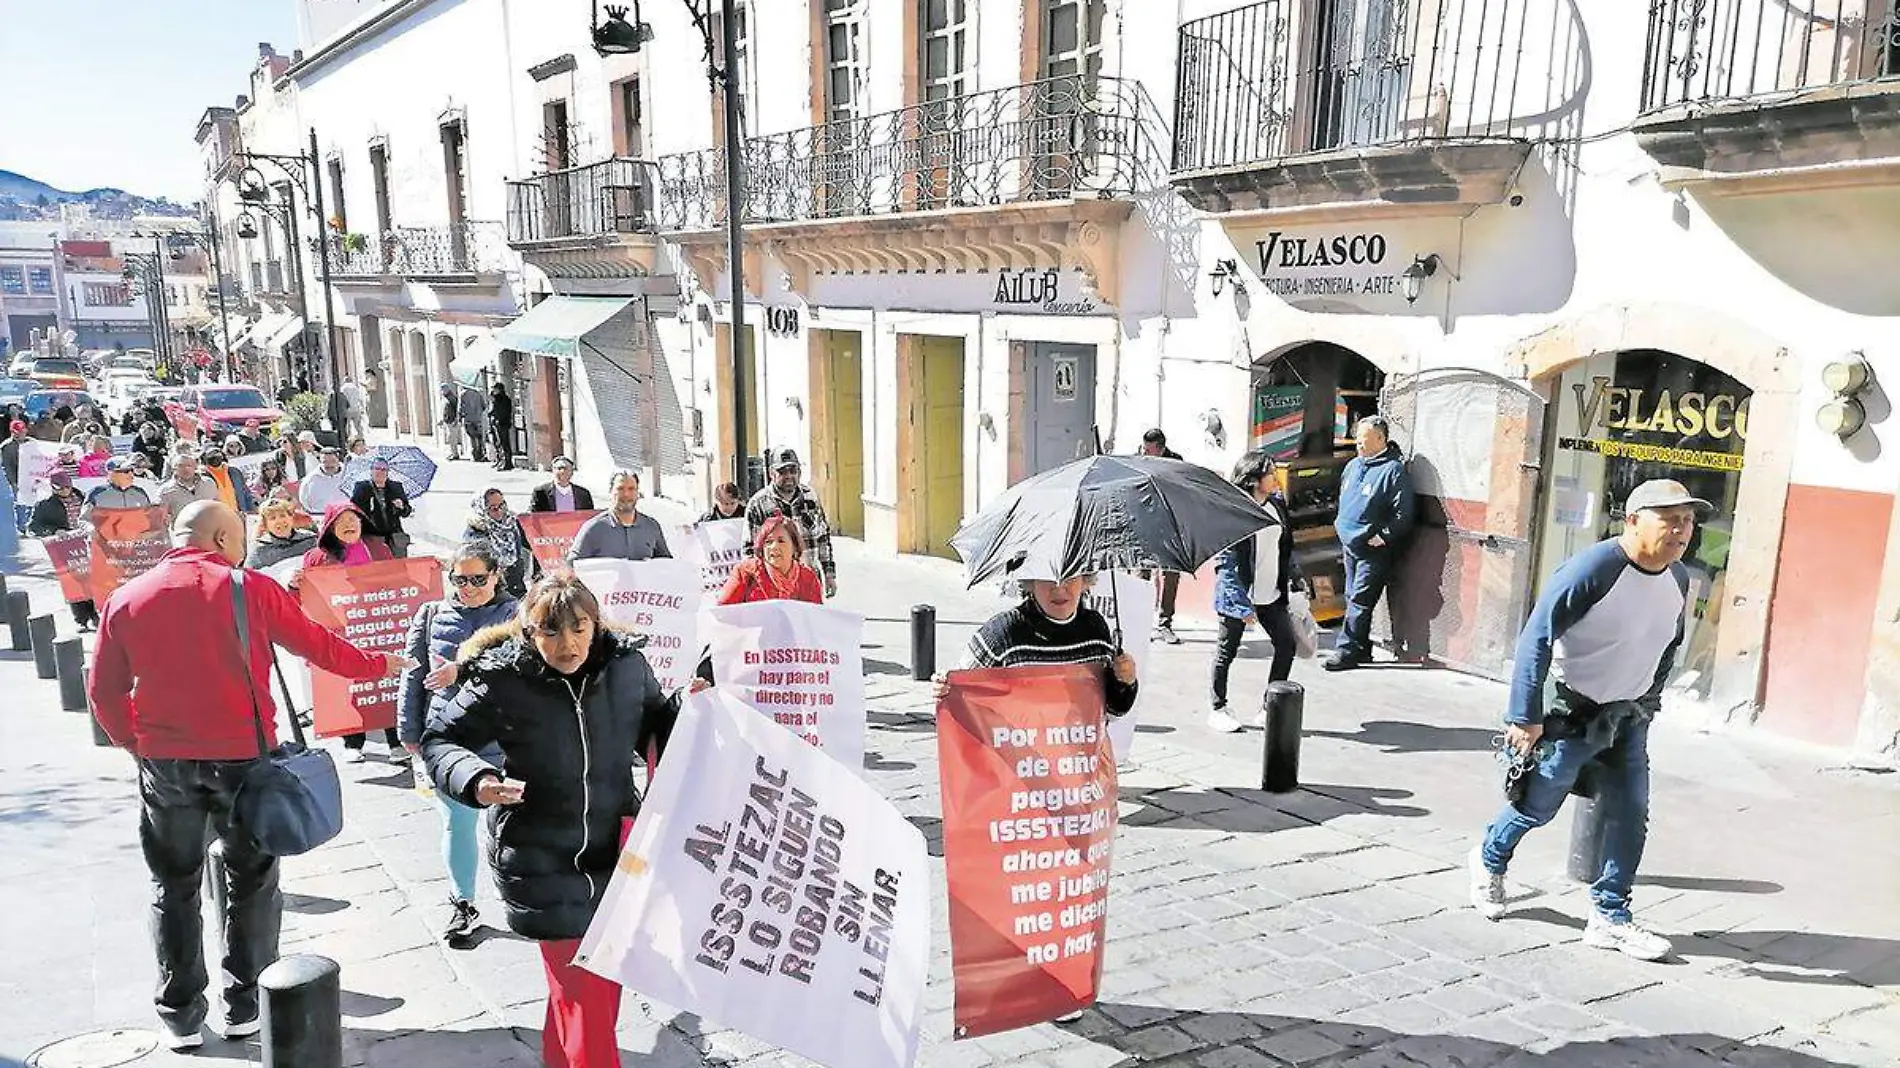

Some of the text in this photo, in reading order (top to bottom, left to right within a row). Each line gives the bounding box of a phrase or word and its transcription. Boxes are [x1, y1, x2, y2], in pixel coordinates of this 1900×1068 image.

[1256, 232, 1386, 276] VELASCO
[1361, 275, 1394, 294] ARTE
[1628, 442, 1671, 461] EQUIPOS
[1674, 448, 1702, 464] PARA
[1703, 451, 1743, 471] INGENIE
[330, 587, 418, 606] Por más 30
[604, 591, 683, 610] ISSSTEZAC
[346, 603, 408, 619] de años
[636, 611, 653, 626] ES
[345, 618, 395, 636] pagué
[744, 651, 759, 664] En
[763, 648, 828, 664] ISSSTEZAC
[348, 677, 401, 693] me dic
[759, 670, 829, 685] hay para el
[357, 692, 398, 706] no ha
[756, 690, 834, 706] director y no
[806, 711, 817, 725] el
[992, 721, 1097, 748] Por más
[1016, 756, 1049, 778] de
[683, 820, 731, 873] AL
[1003, 838, 1109, 873] ahora que
[695, 755, 788, 974] ISSSTEZAC
[739, 787, 818, 976] LO SIGUEN
[1011, 881, 1052, 904] me
[779, 814, 846, 984] ROBANDO
[834, 880, 867, 943] SIN
[1014, 898, 1107, 935] me dicen
[853, 867, 902, 1007] LLENAR.
[1027, 942, 1059, 964] no
